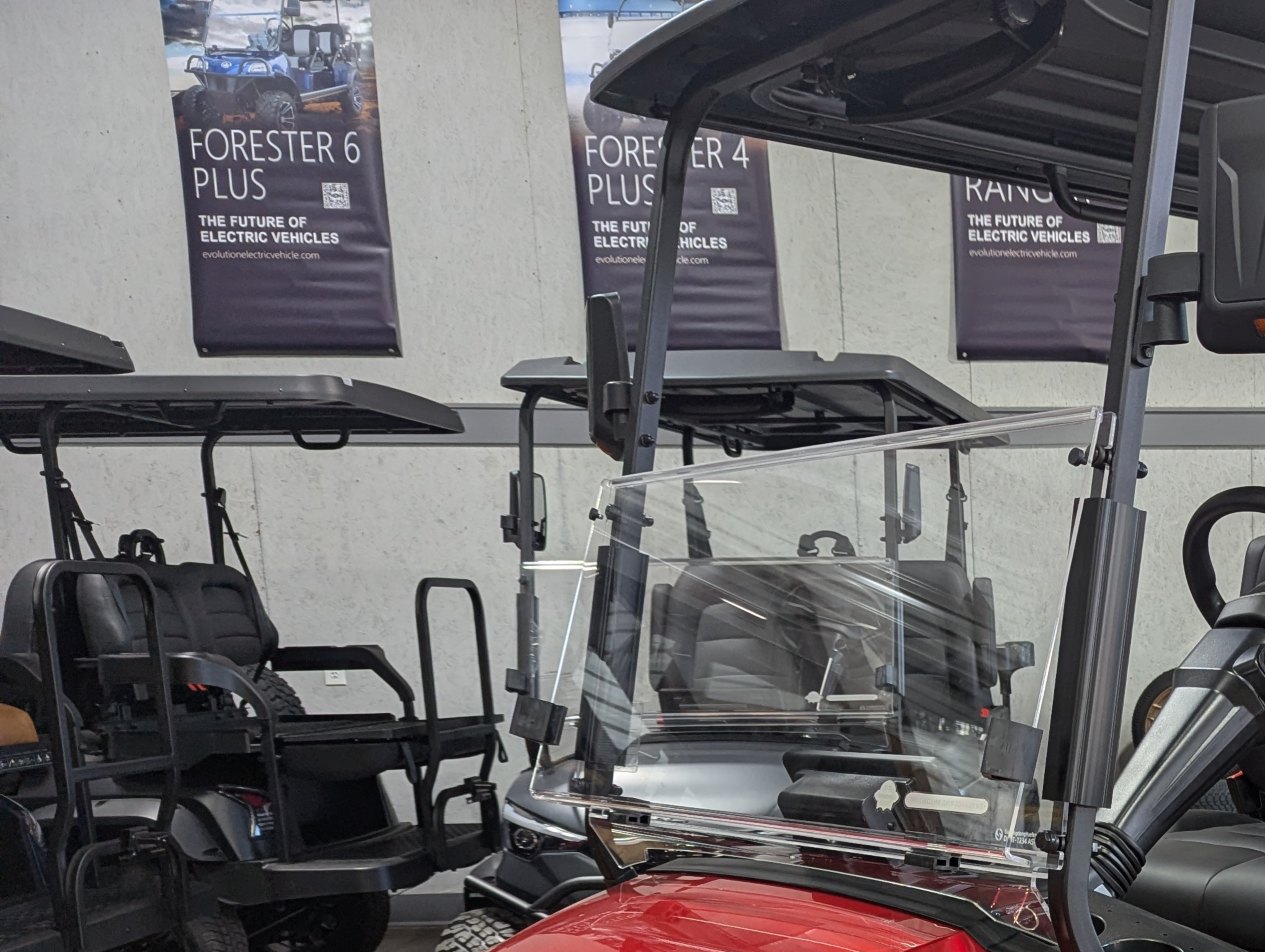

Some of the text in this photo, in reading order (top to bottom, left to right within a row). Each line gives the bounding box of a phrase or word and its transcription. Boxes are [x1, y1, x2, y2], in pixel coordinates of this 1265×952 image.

[189, 128, 361, 164] FORESTER 6
[584, 135, 750, 169] FOREER 4
[193, 167, 267, 201] PLUS
[198, 214, 307, 229] THE FUTURE OF
[592, 220, 697, 233] THE FUT OF
[967, 214, 1063, 228] THE FUTURE OF
[200, 231, 340, 244] ELECTRIC VEHICLES
[593, 236, 728, 249] ELECTRI HICLES
[968, 229, 1091, 244] ELECTRIC VEHICLES
[202, 250, 320, 260] evolutionelectricvehicle.com
[969, 248, 1078, 258] evolutionelectricvehicle.com
